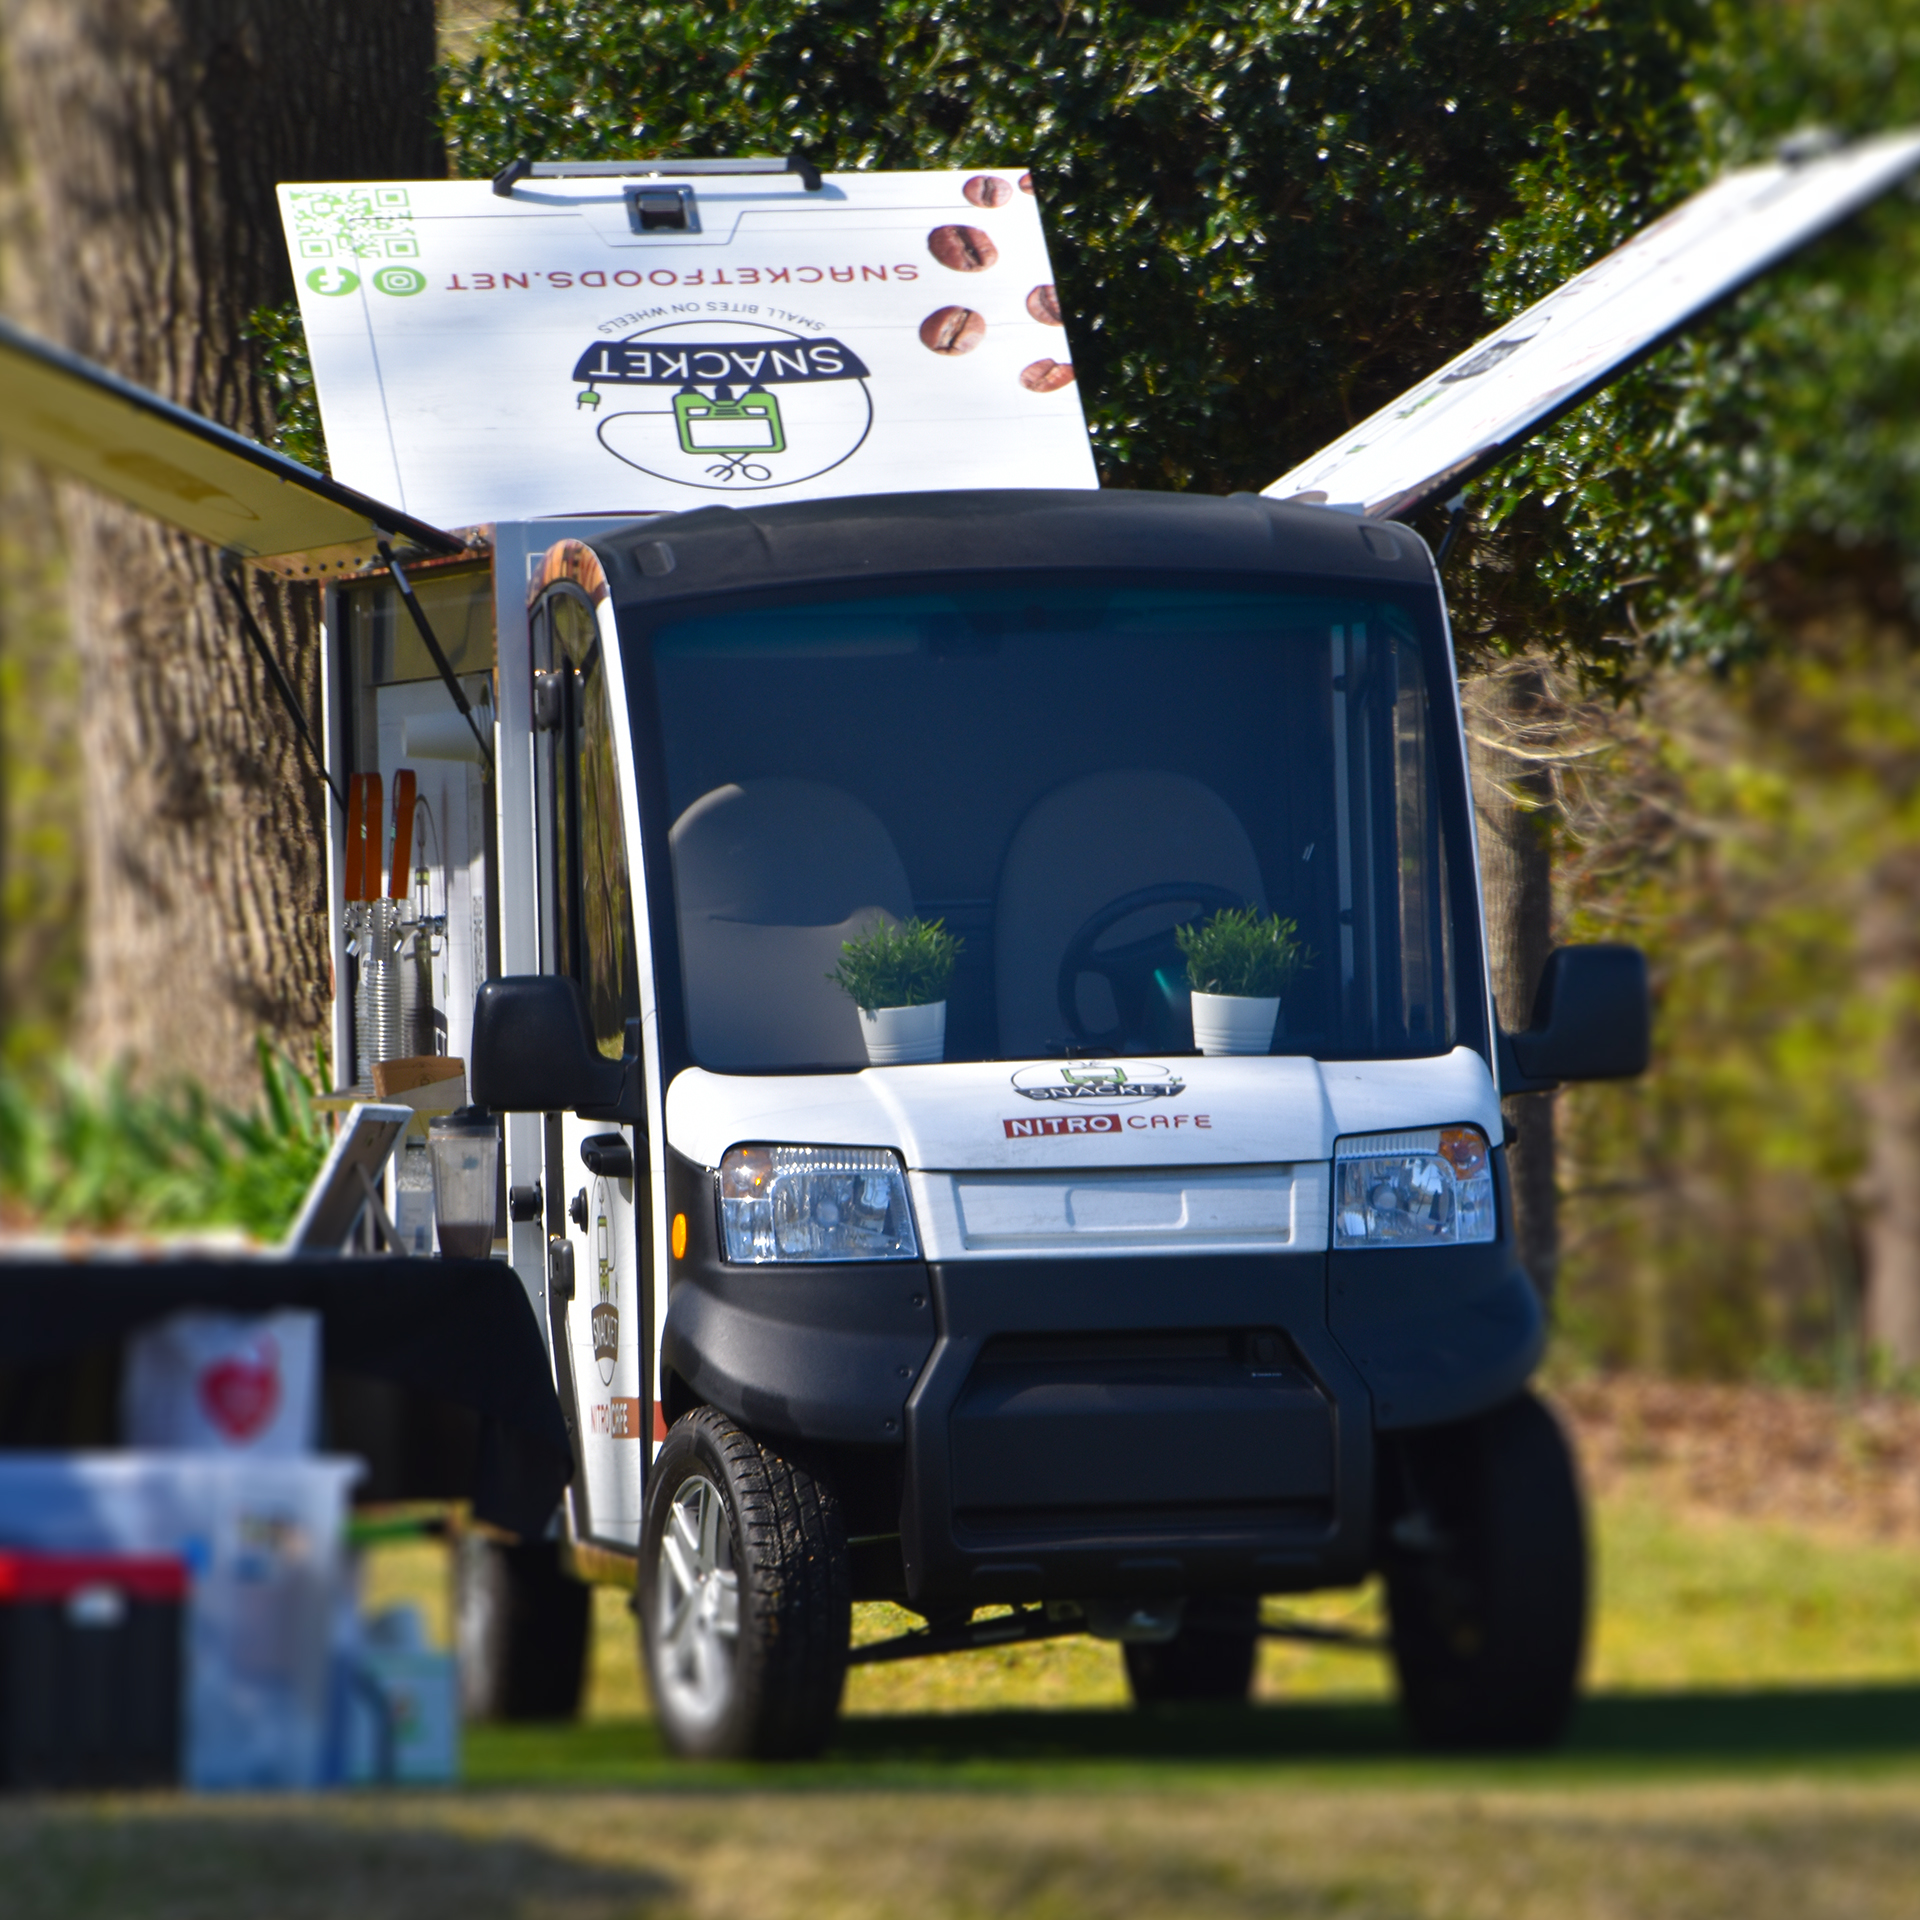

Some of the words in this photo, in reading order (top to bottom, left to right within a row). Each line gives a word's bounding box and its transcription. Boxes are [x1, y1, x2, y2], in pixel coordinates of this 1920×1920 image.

[445, 264, 918, 291] SNACKETFOODS.NET
[597, 305, 668, 334] WHEELS
[671, 301, 700, 314] ON
[706, 301, 758, 314] BITES
[766, 306, 825, 332] SMALL
[588, 344, 844, 378] SNACKET
[1030, 1085, 1174, 1099] SNACKET
[1013, 1116, 1112, 1137] NITRO
[1127, 1114, 1212, 1130] CAFE
[590, 1404, 610, 1435] NITRO
